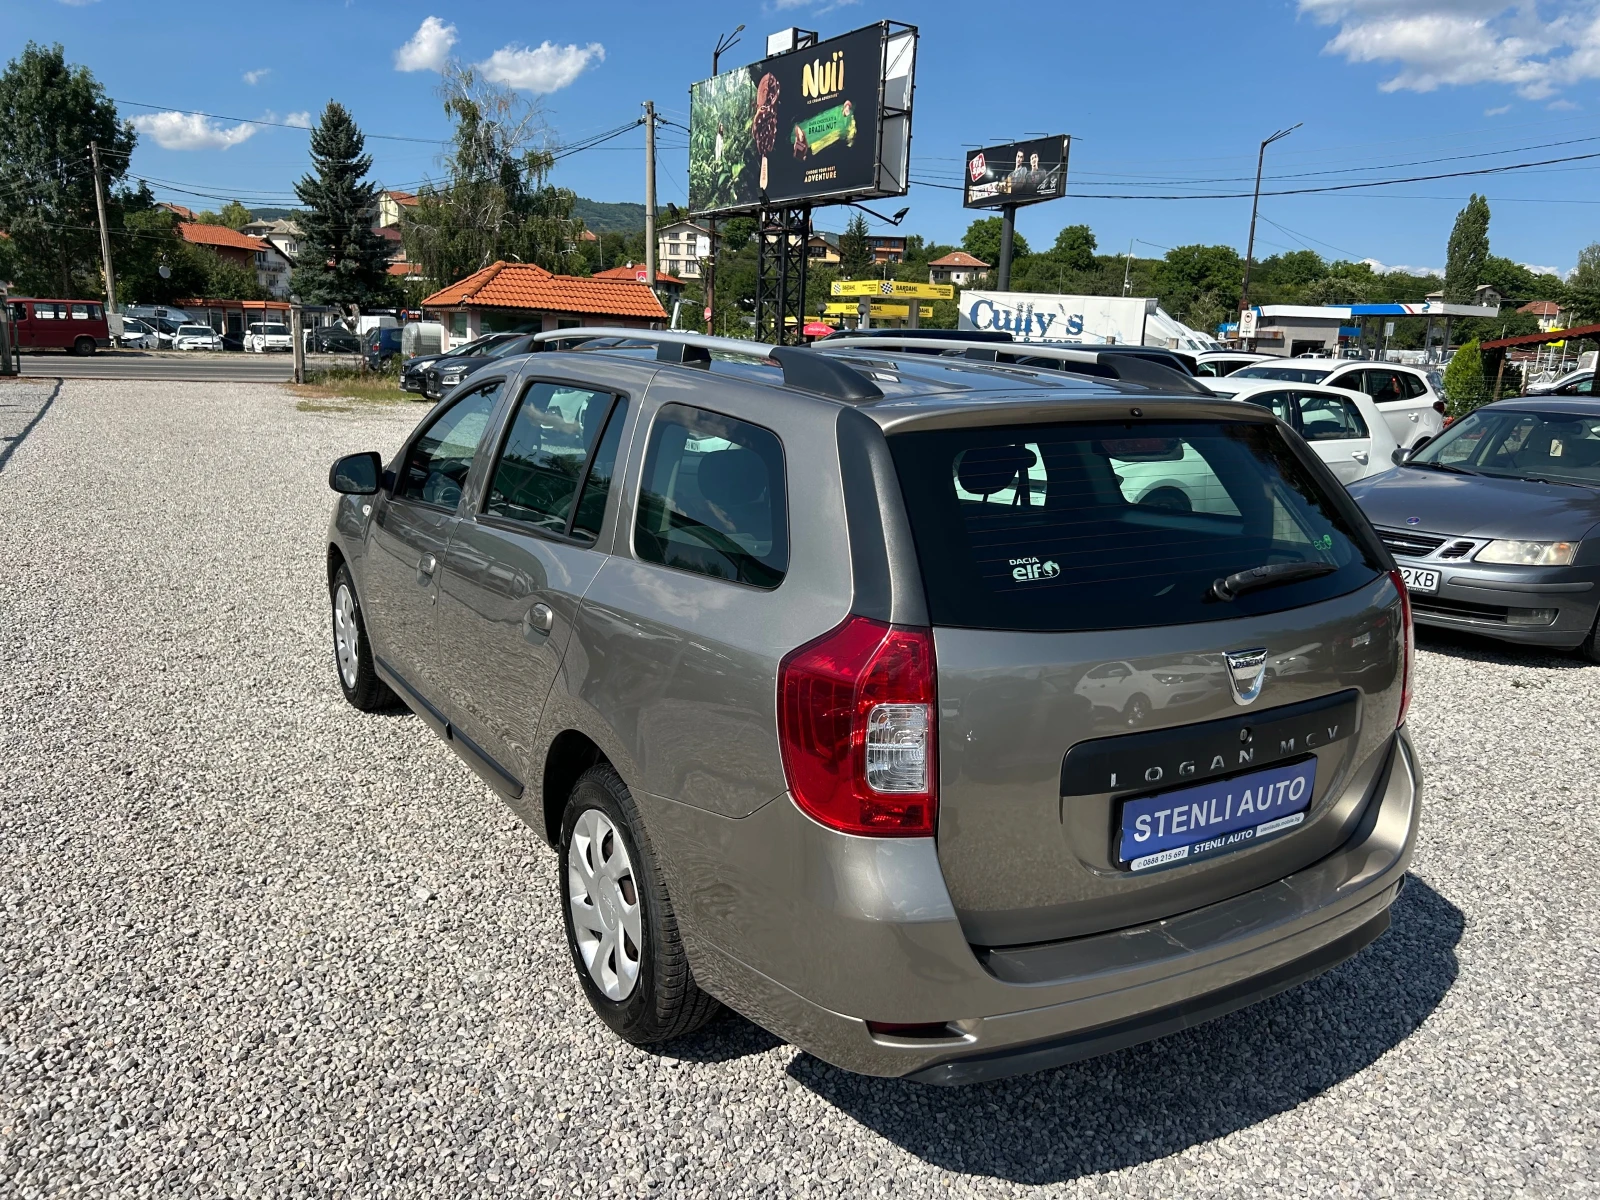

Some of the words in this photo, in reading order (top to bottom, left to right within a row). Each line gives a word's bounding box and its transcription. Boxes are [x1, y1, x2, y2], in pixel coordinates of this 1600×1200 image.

[809, 124, 825, 135] BRAZIL
[826, 121, 837, 130] NUT
[804, 171, 837, 183] ADVENTURE
[895, 285, 918, 294] BARDAHL
[1009, 556, 1040, 566] DACIA
[1012, 563, 1042, 580] elf
[1403, 569, 1435, 588] 2KB
[1110, 748, 1254, 788] LOGAN
[1279, 725, 1339, 754] MCV
[1132, 794, 1232, 843] STENLI
[1237, 776, 1306, 818] AUTO
[1194, 838, 1225, 854] STENLI
[1228, 829, 1254, 846] AUTO
[1142, 855, 1159, 867] 0888
[1160, 853, 1172, 862] 215
[1173, 850, 1186, 860] 697
